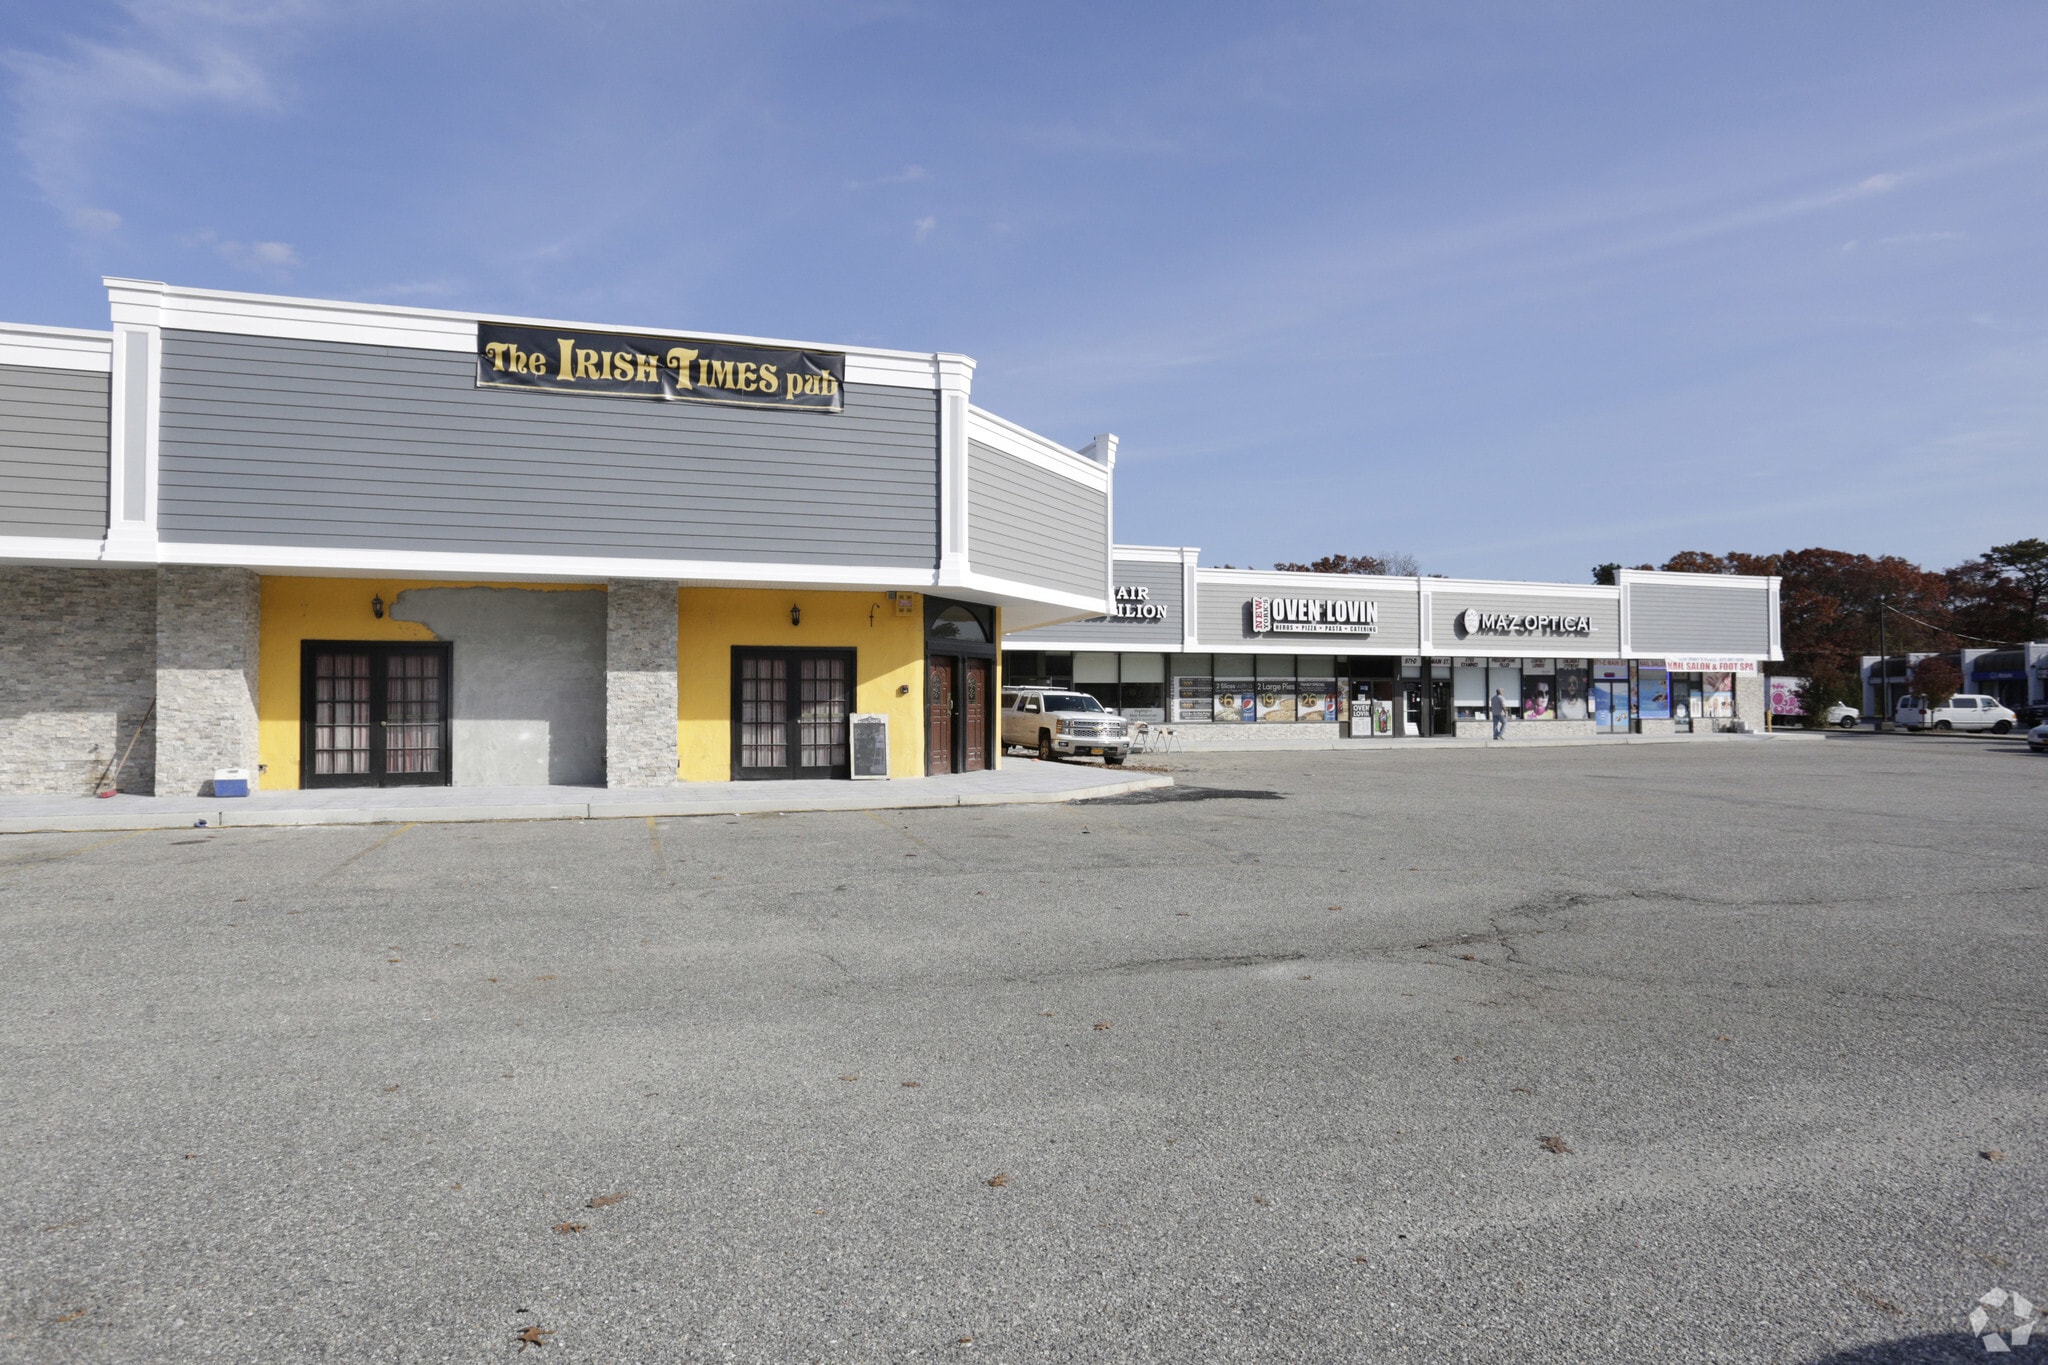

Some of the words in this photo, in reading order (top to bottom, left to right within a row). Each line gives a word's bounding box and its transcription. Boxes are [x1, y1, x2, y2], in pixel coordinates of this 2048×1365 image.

[486, 341, 547, 376] The
[557, 338, 660, 383] IRISH
[666, 347, 778, 393] TIMES
[786, 369, 838, 401] pub
[1113, 585, 1150, 600] AIR
[1255, 599, 1263, 629] NEW
[1272, 597, 1320, 621] OVEN
[1326, 600, 1378, 623] LOVIN
[1275, 623, 1293, 631] HEROS
[1349, 625, 1377, 633] CATERING
[1525, 615, 1599, 632] OPTICAL
[1667, 661, 1684, 671] NAIL
[1686, 662, 1711, 671] SALON
[1711, 663, 1718, 671] &
[1719, 662, 1738, 671] FOOT
[1739, 662, 1754, 671] SPA
[1262, 682, 1281, 692] Large
[1282, 682, 1295, 690] Pies
